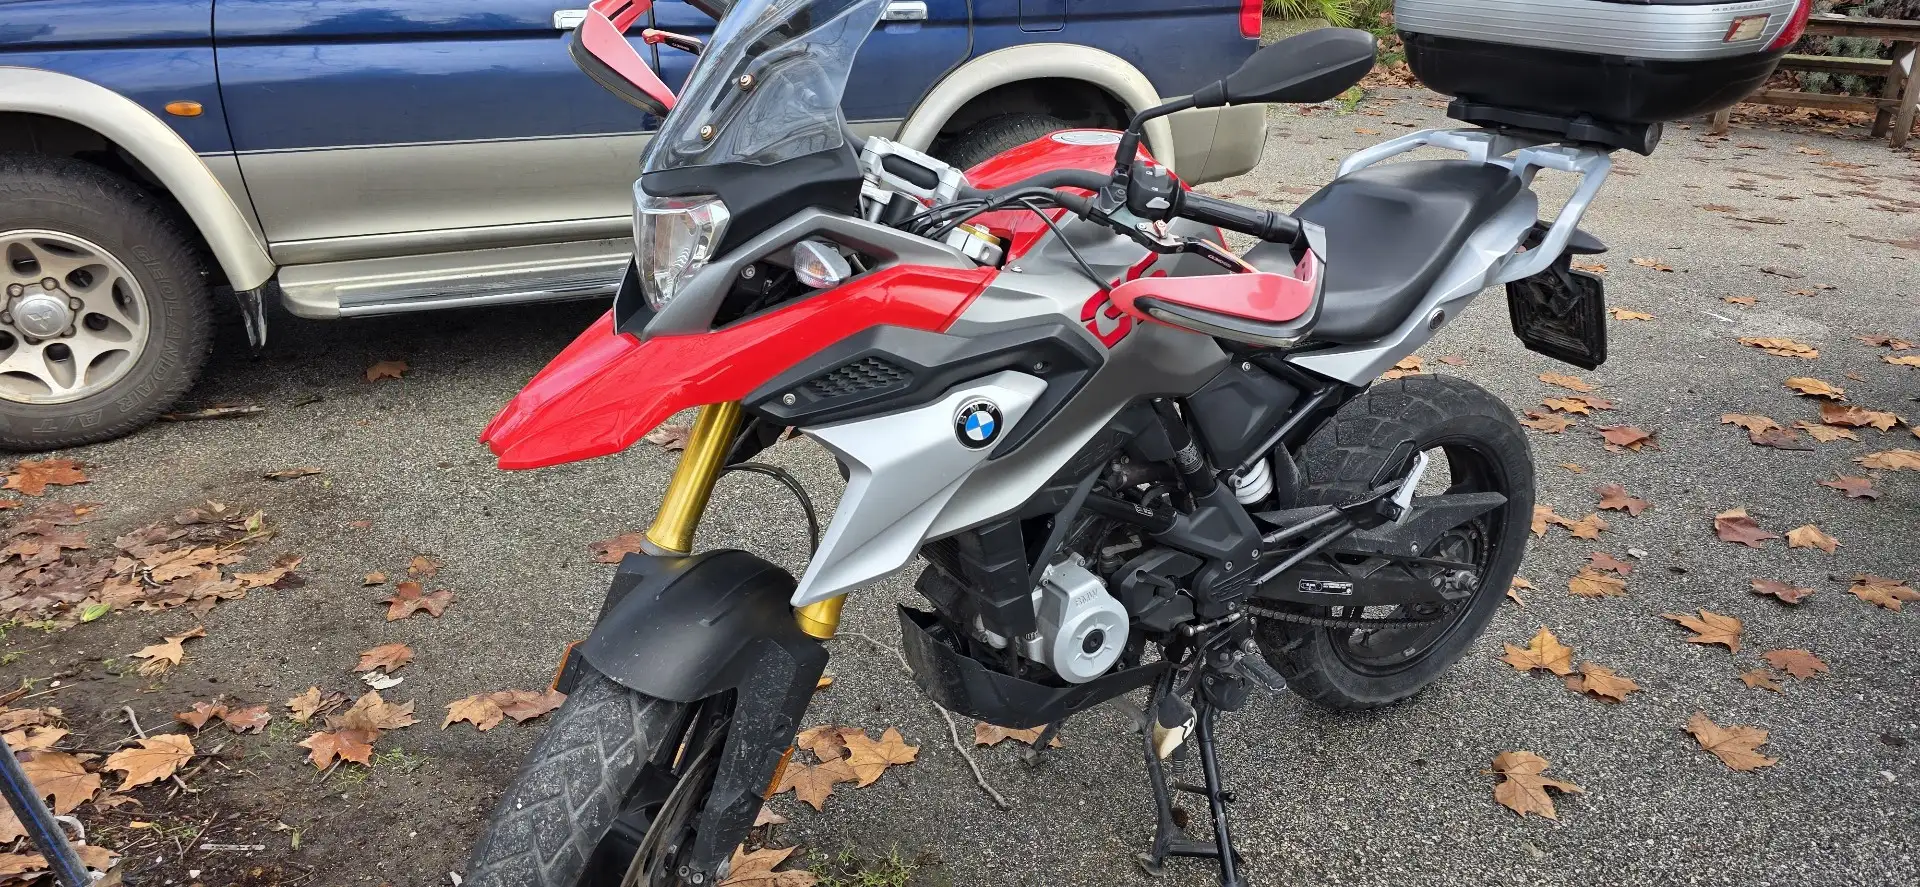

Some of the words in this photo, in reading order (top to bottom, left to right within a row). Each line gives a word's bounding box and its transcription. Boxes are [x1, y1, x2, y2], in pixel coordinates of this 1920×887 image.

[117, 244, 185, 413] GEOLANDAR
[32, 408, 104, 433] A/T
[957, 402, 997, 425] BMW
[1074, 588, 1099, 607] BMW
